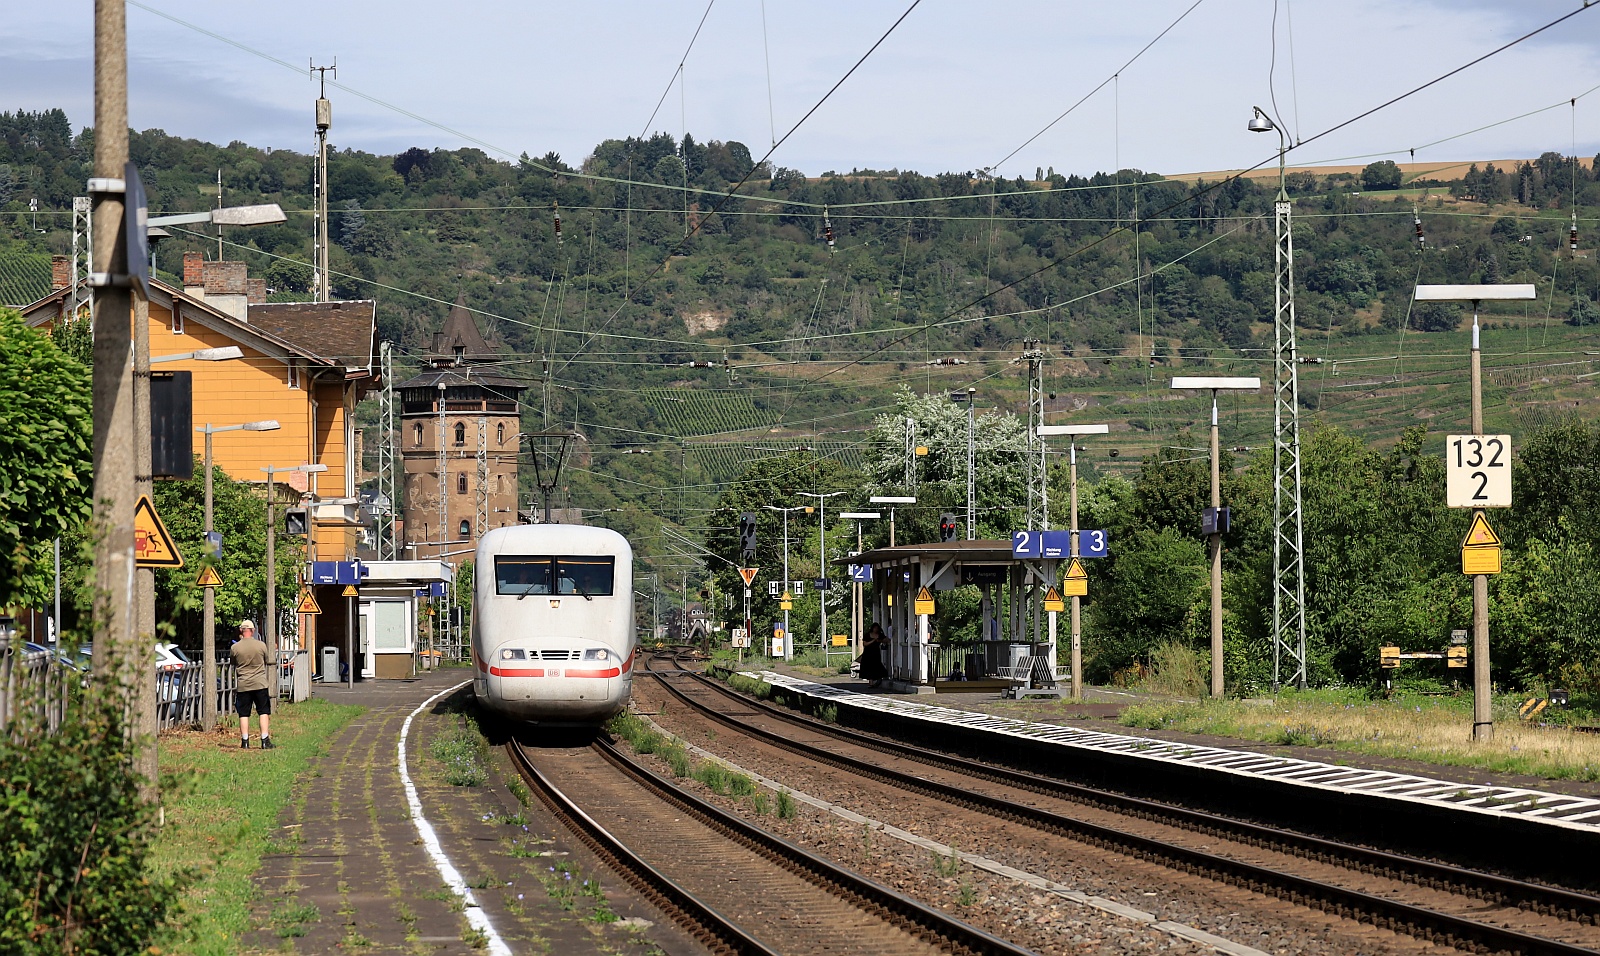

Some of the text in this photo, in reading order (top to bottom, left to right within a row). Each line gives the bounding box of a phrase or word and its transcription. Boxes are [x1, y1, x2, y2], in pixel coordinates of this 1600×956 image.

[1453, 438, 1504, 467] 132
[1471, 471, 1488, 500] 2
[1015, 531, 1030, 553] 2
[1090, 530, 1104, 552] 3
[350, 561, 358, 580] 1
[745, 569, 753, 579] 10
[854, 564, 864, 579] 2
[439, 582, 445, 594] 1
[770, 582, 778, 594] H
[795, 582, 803, 594] H
[734, 630, 747, 638] 132
[737, 638, 744, 646] 0
